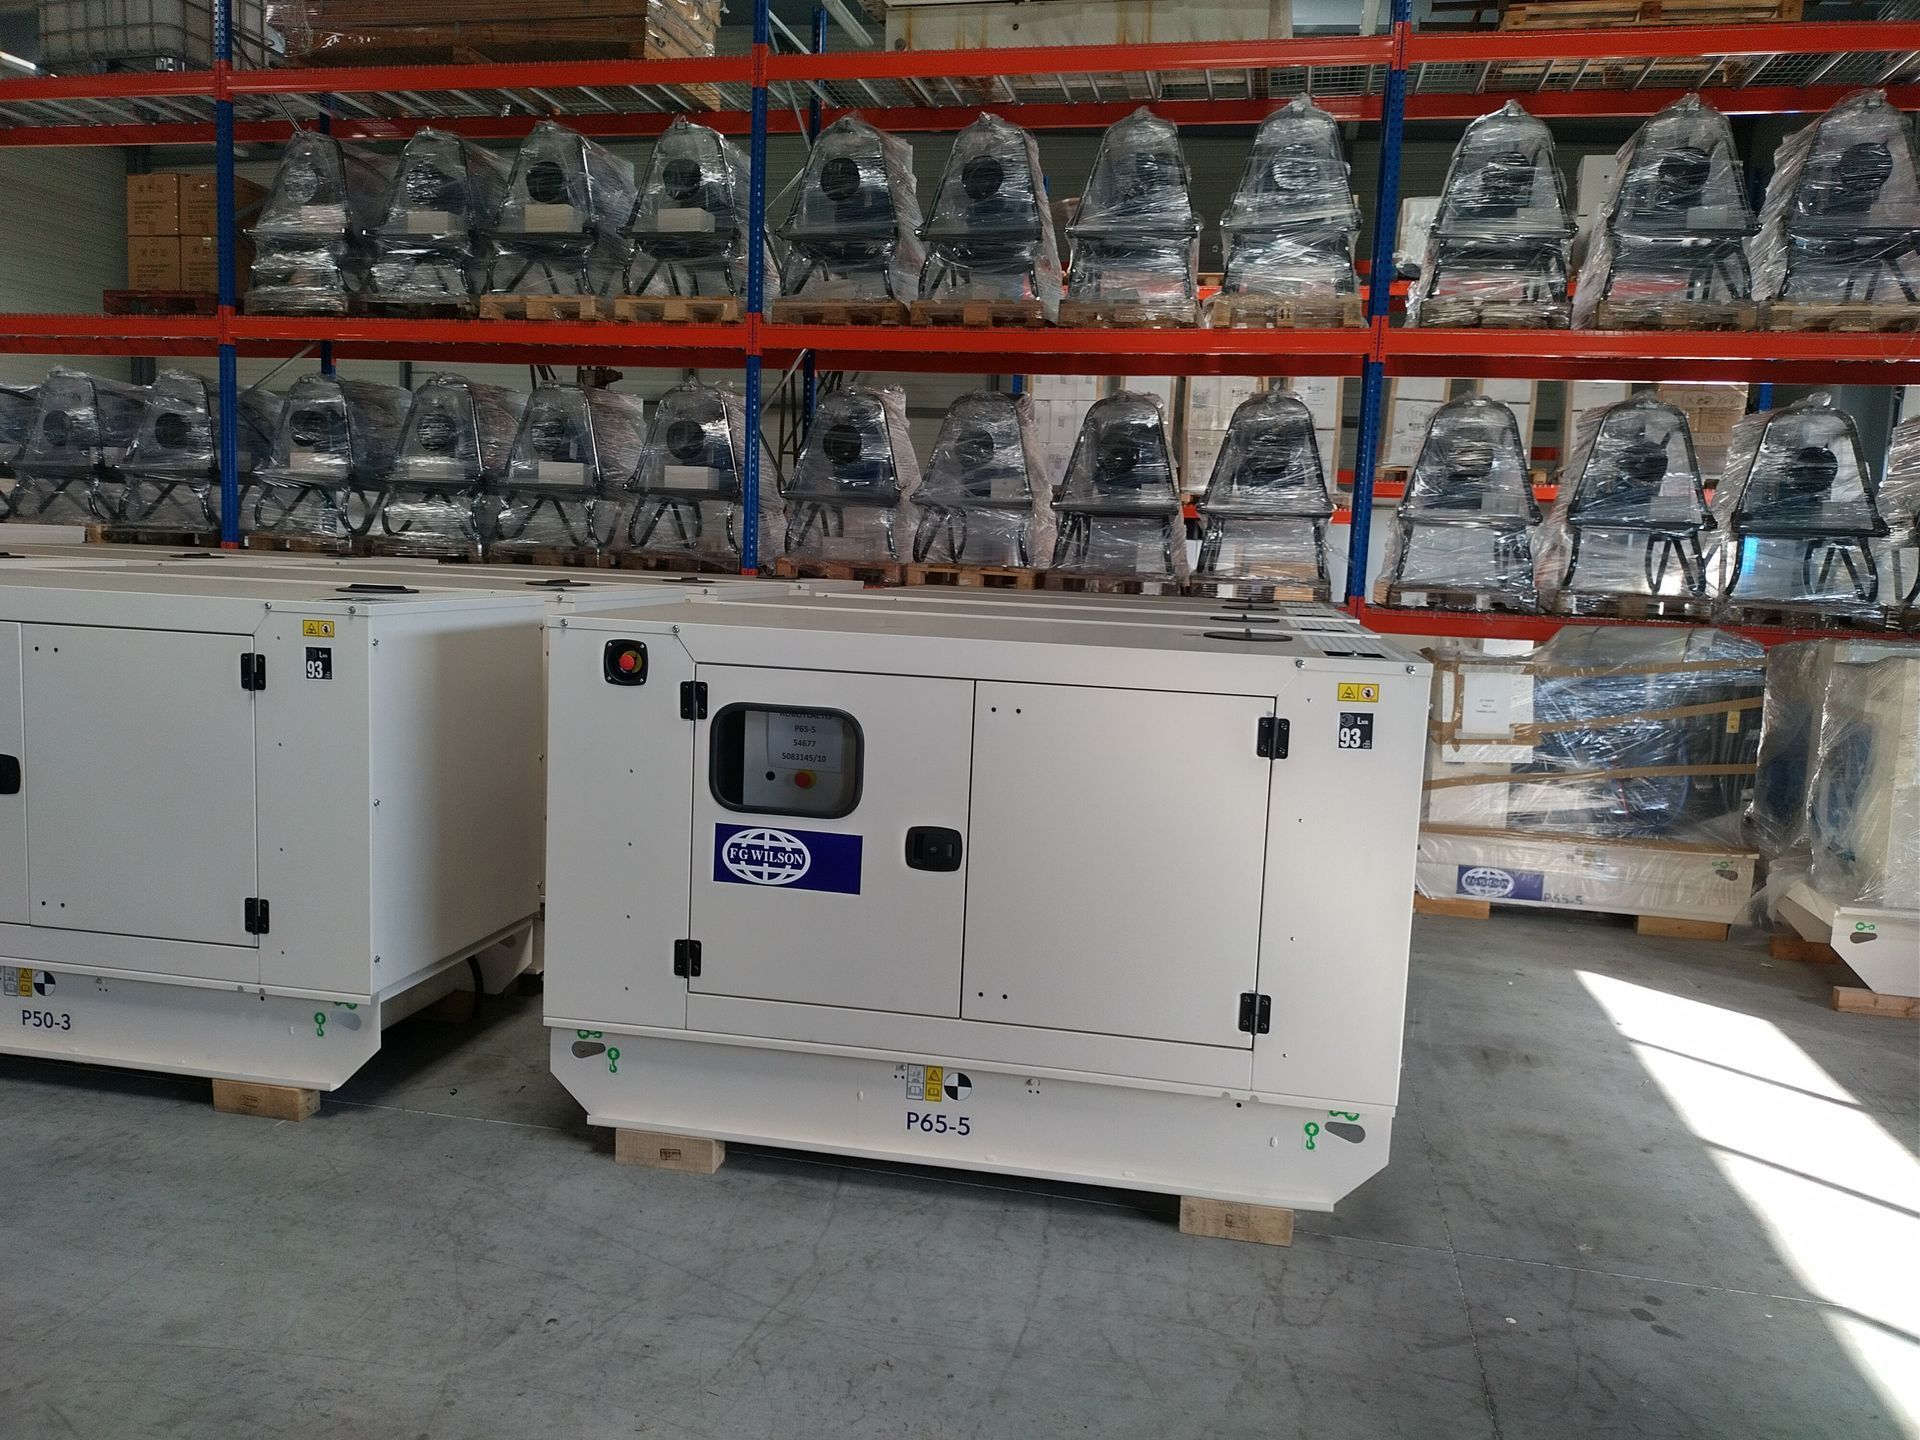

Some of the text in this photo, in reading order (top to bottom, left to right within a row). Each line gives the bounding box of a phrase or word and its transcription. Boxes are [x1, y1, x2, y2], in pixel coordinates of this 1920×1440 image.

[307, 660, 323, 678] 93
[794, 724, 816, 734] P65-5
[1340, 727, 1361, 748] 93
[793, 739, 817, 748] 54677
[781, 752, 827, 763] 5083145/10
[751, 849, 804, 865] WILSON
[22, 1009, 71, 1031] P50-3
[906, 1111, 970, 1136] P65-5
